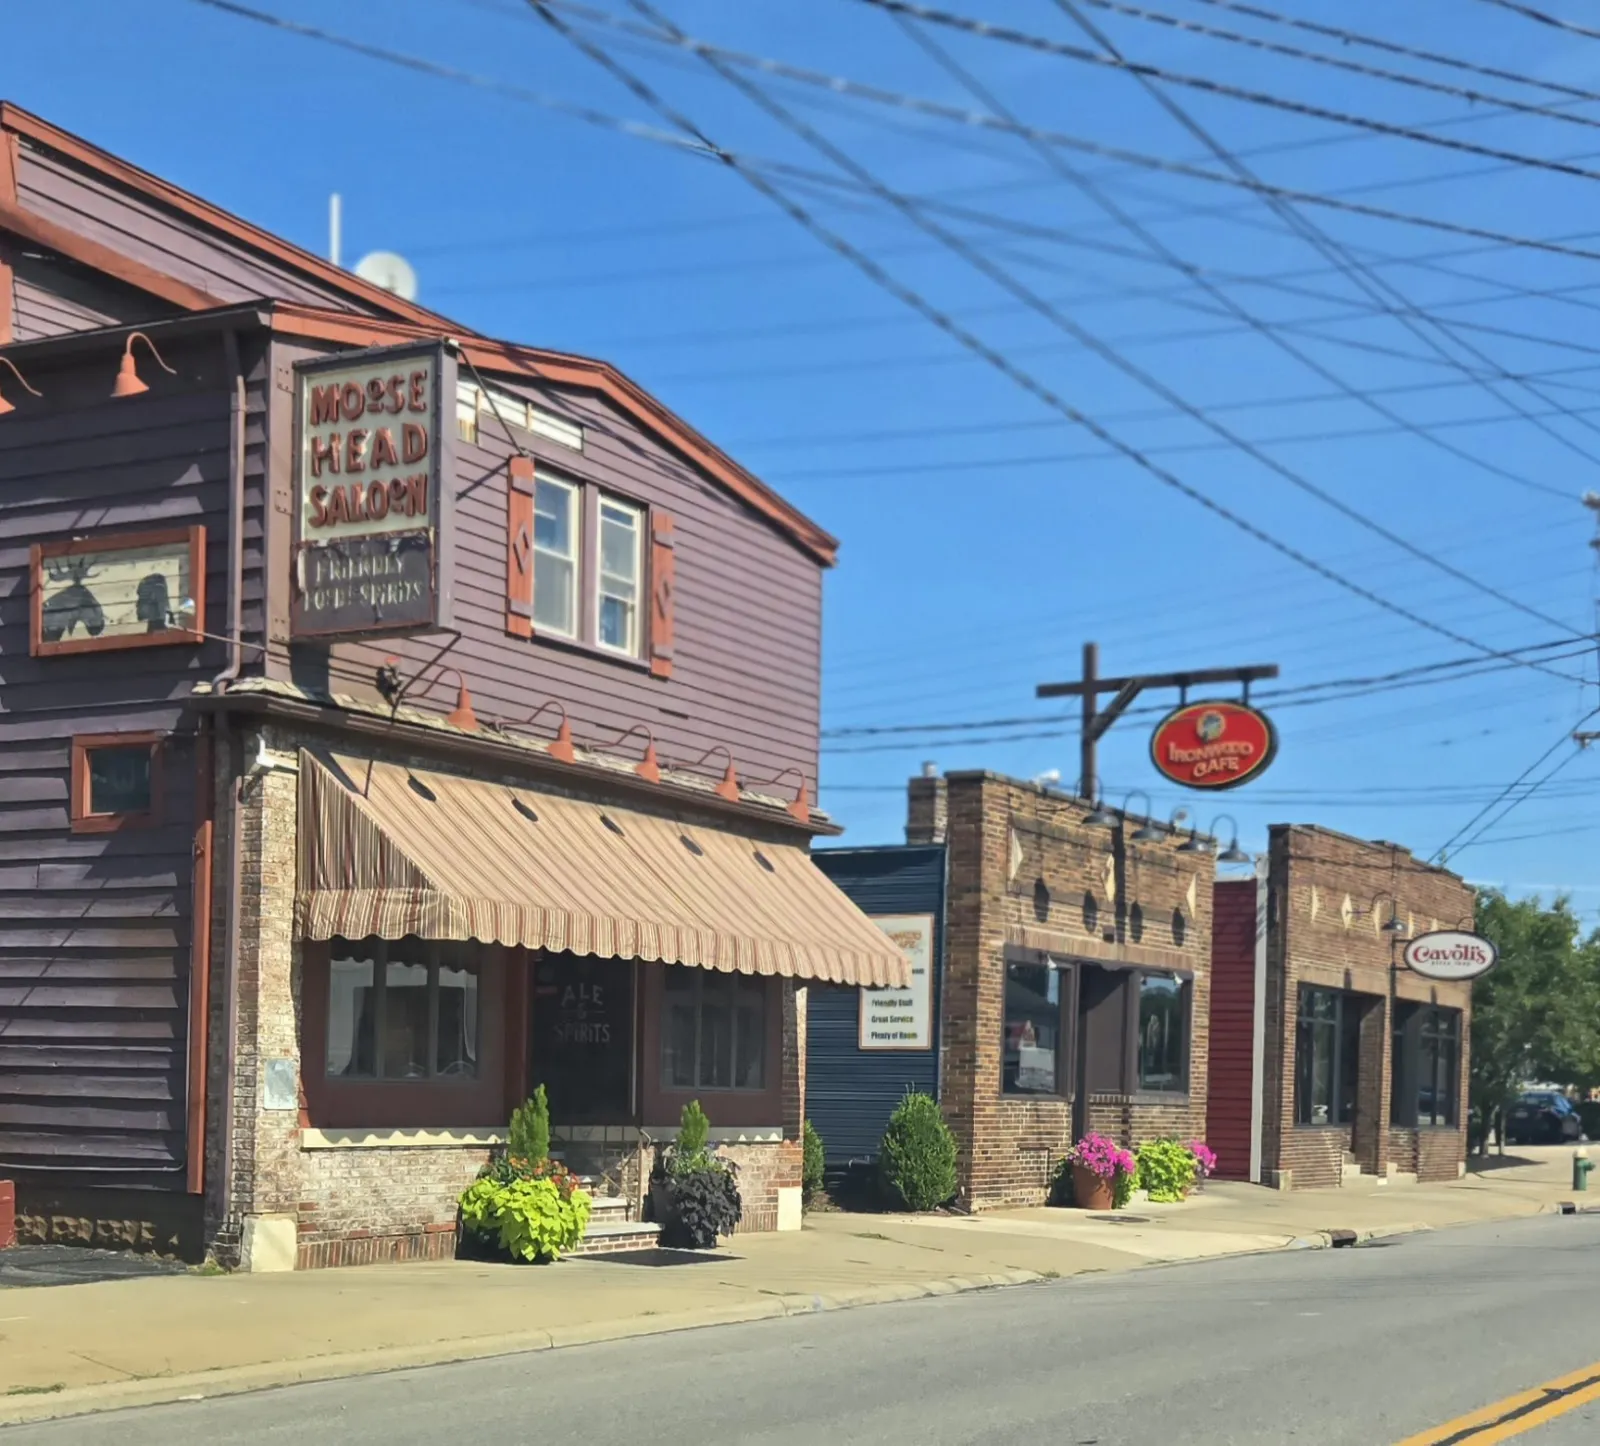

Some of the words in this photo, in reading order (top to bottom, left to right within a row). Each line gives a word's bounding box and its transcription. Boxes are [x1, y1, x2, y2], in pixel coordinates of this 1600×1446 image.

[310, 369, 428, 426] MOOSE
[311, 423, 428, 477] HEAD
[308, 473, 428, 529] SALOON
[1193, 756, 1239, 777] CAFE
[561, 982, 604, 1008] ALE
[553, 1022, 611, 1044] SPIRITS
